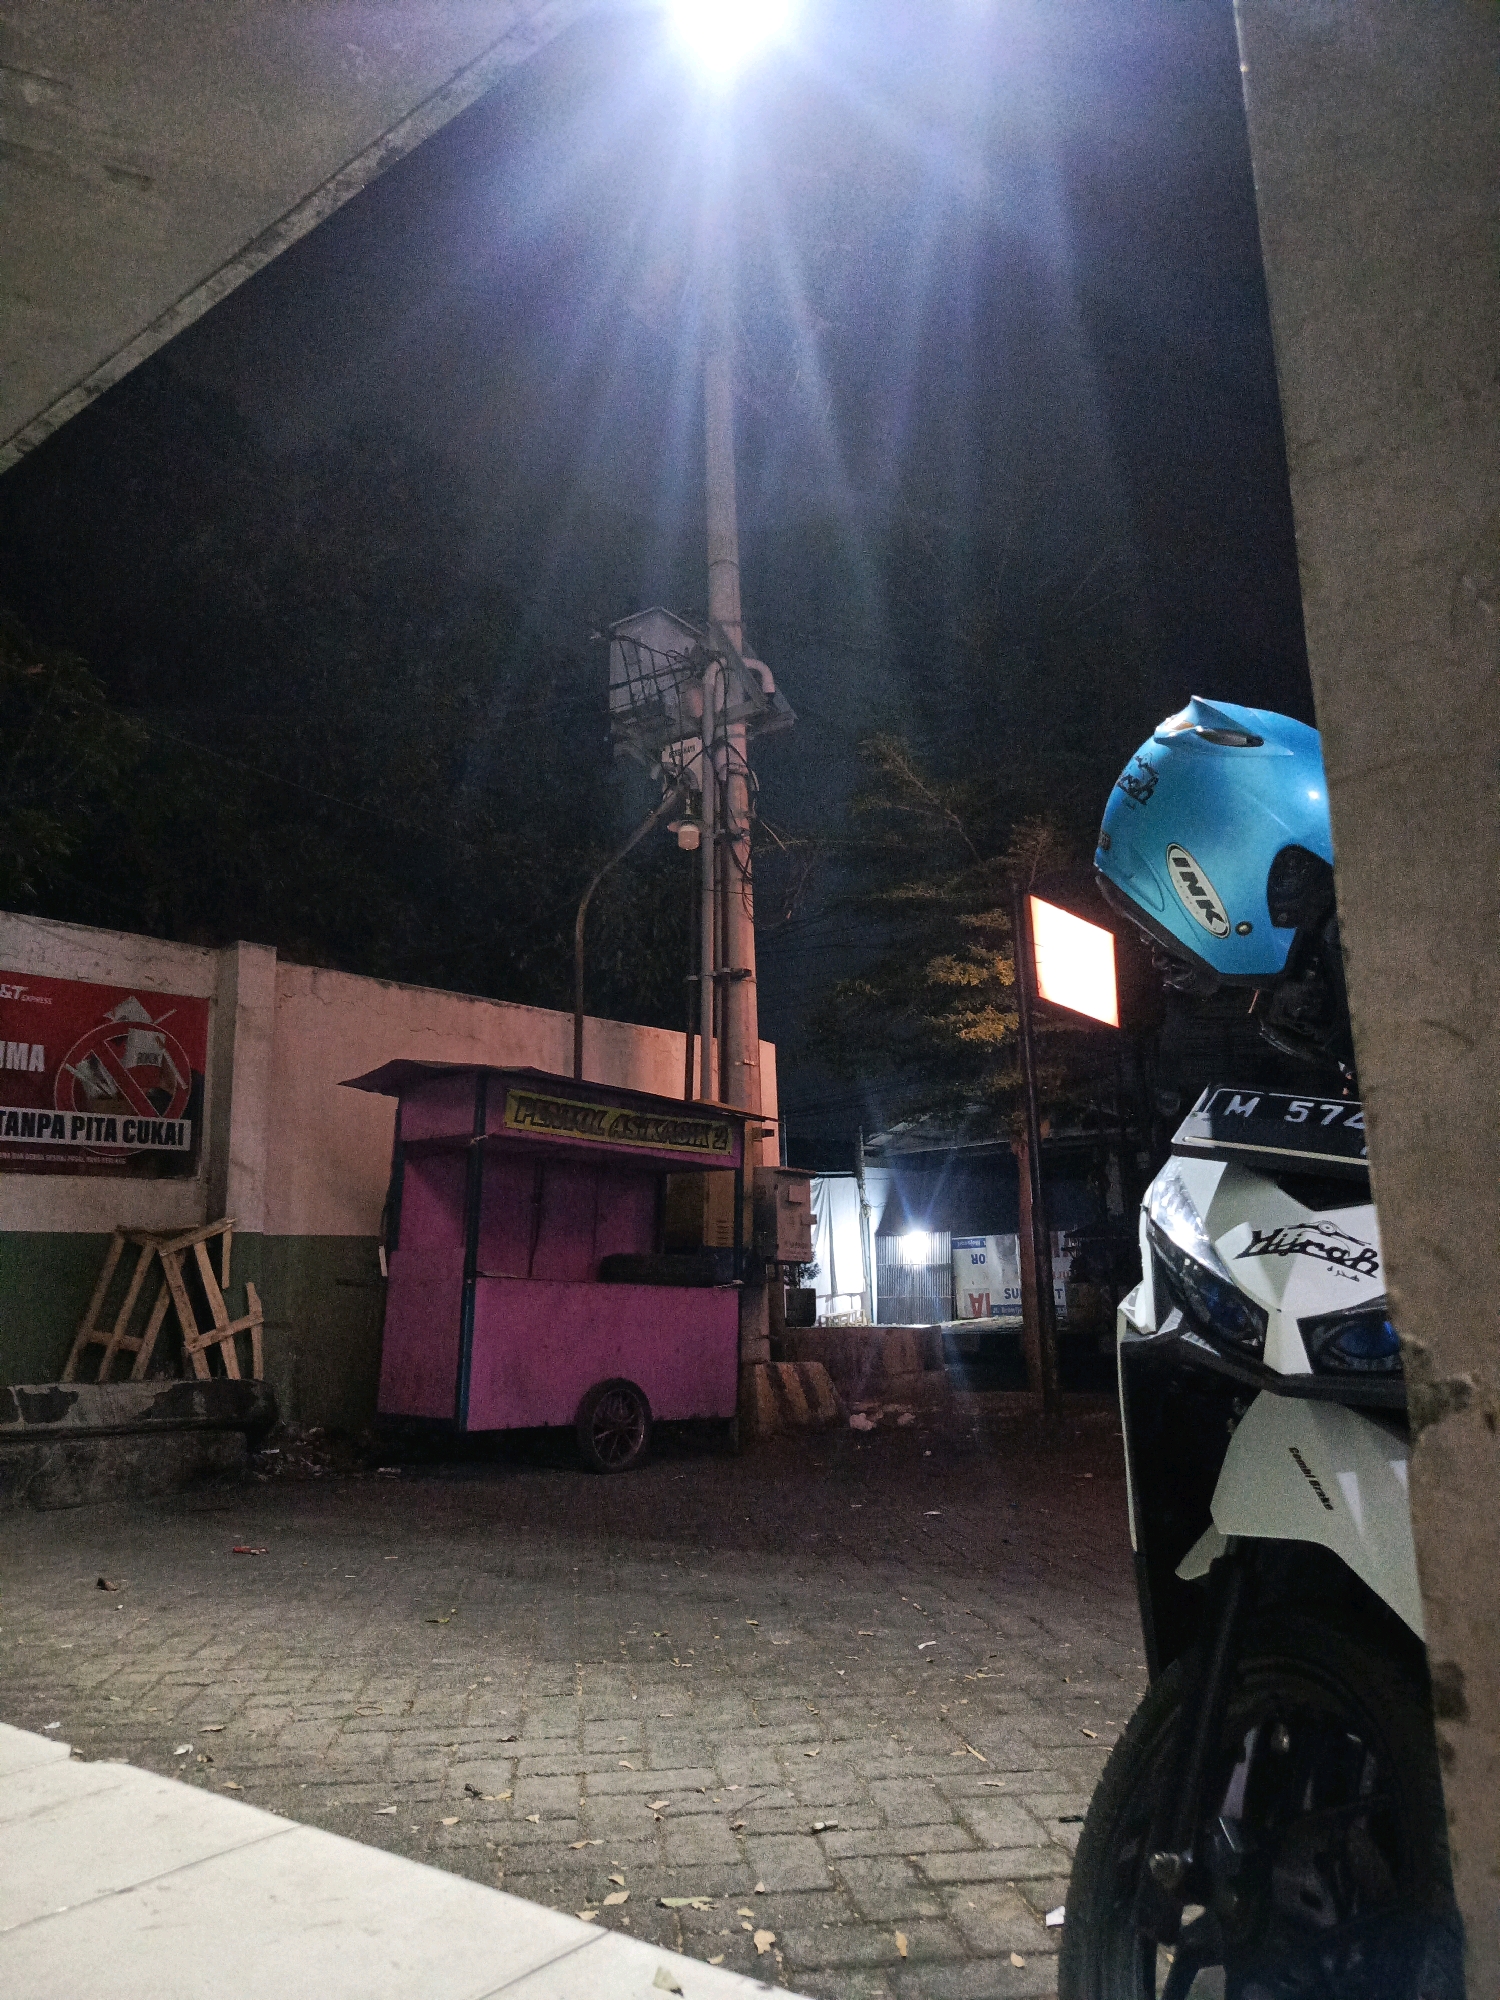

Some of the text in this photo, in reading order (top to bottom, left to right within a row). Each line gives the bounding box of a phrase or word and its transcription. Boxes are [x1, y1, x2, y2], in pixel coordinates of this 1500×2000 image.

[1171, 857, 1226, 926] INK
[1223, 1094, 1261, 1118] M
[71, 1115, 117, 1143] PITA
[122, 1119, 185, 1146] CUKAI
[1308, 1480, 1334, 1510] Brake
